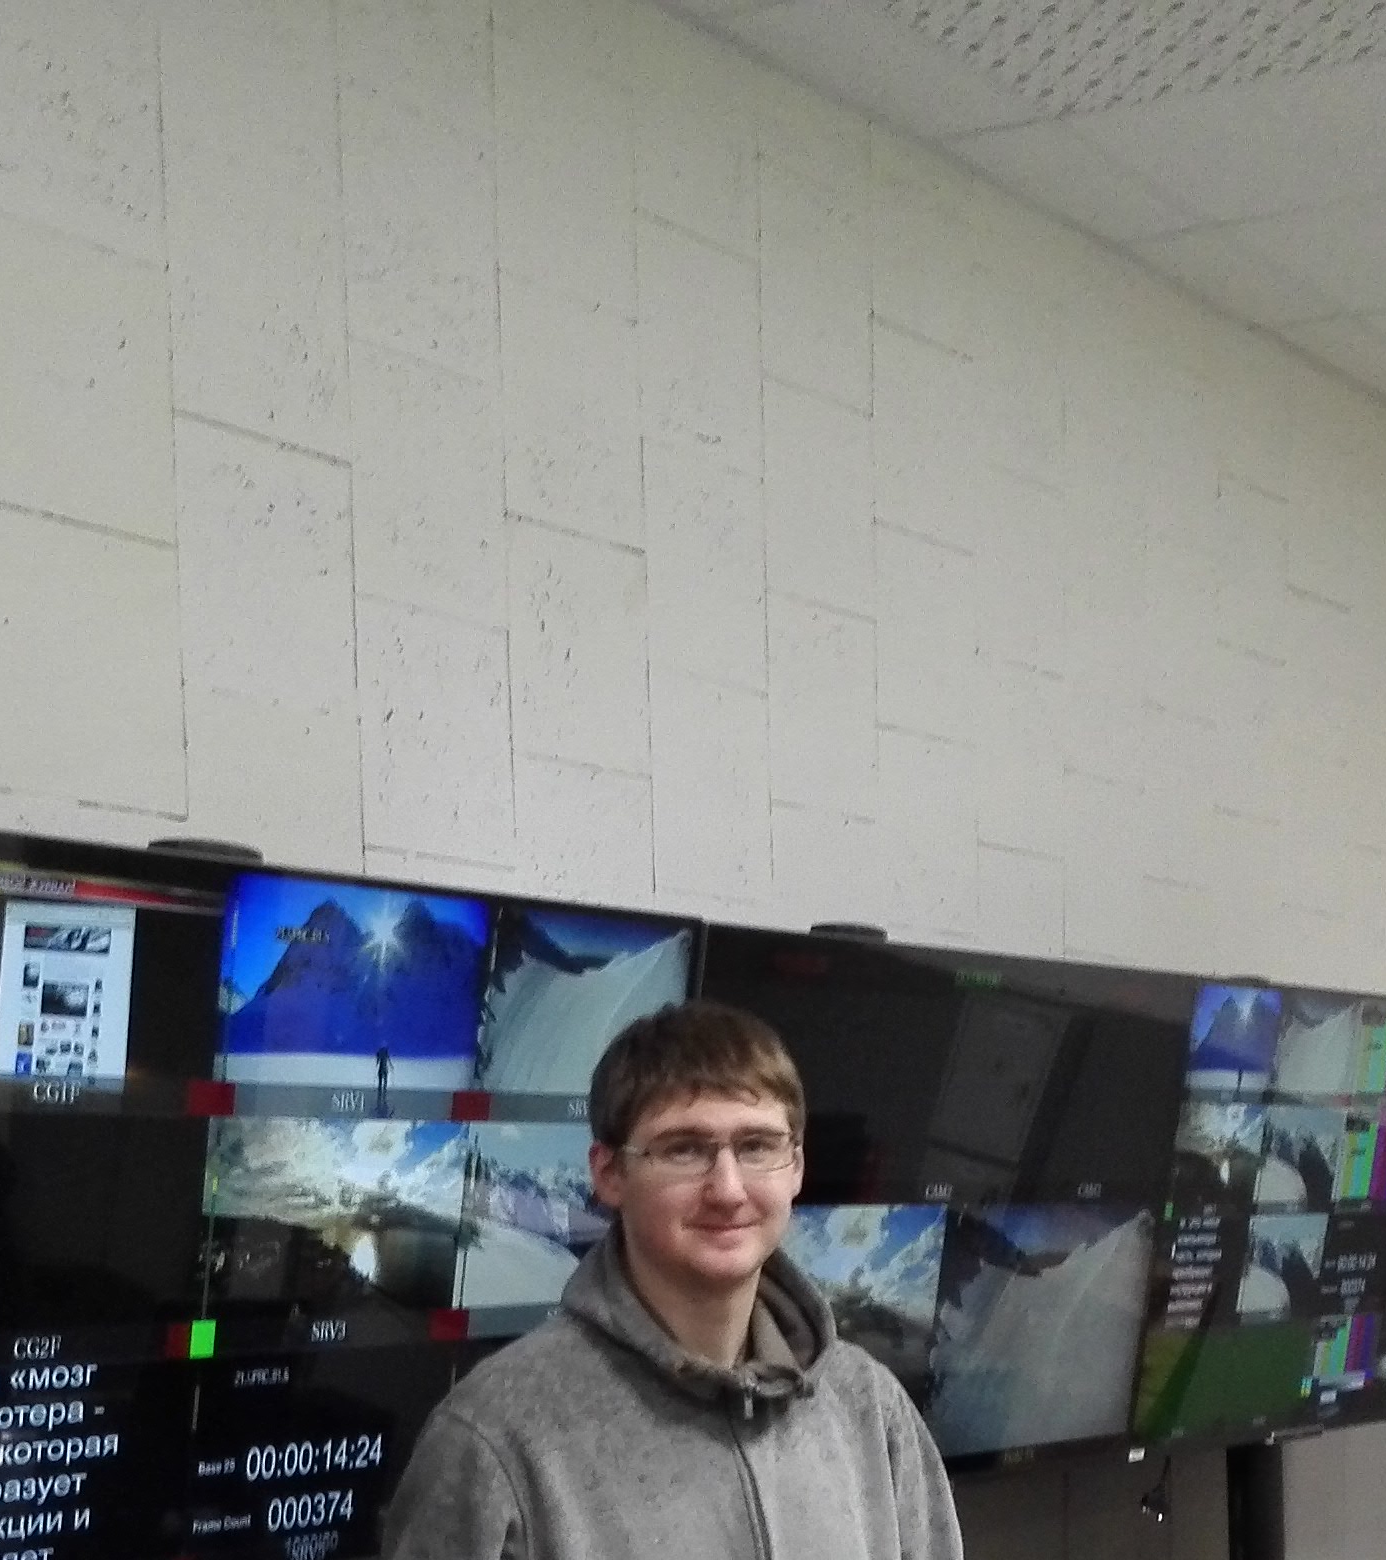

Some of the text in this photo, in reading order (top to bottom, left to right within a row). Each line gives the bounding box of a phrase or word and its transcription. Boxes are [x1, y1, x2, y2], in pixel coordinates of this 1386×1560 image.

[9, 1363, 99, 1391] «мозг
[245, 1432, 383, 1483] 00:00:14:24
[72, 1506, 91, 1531] и
[267, 1488, 355, 1533] 000374
